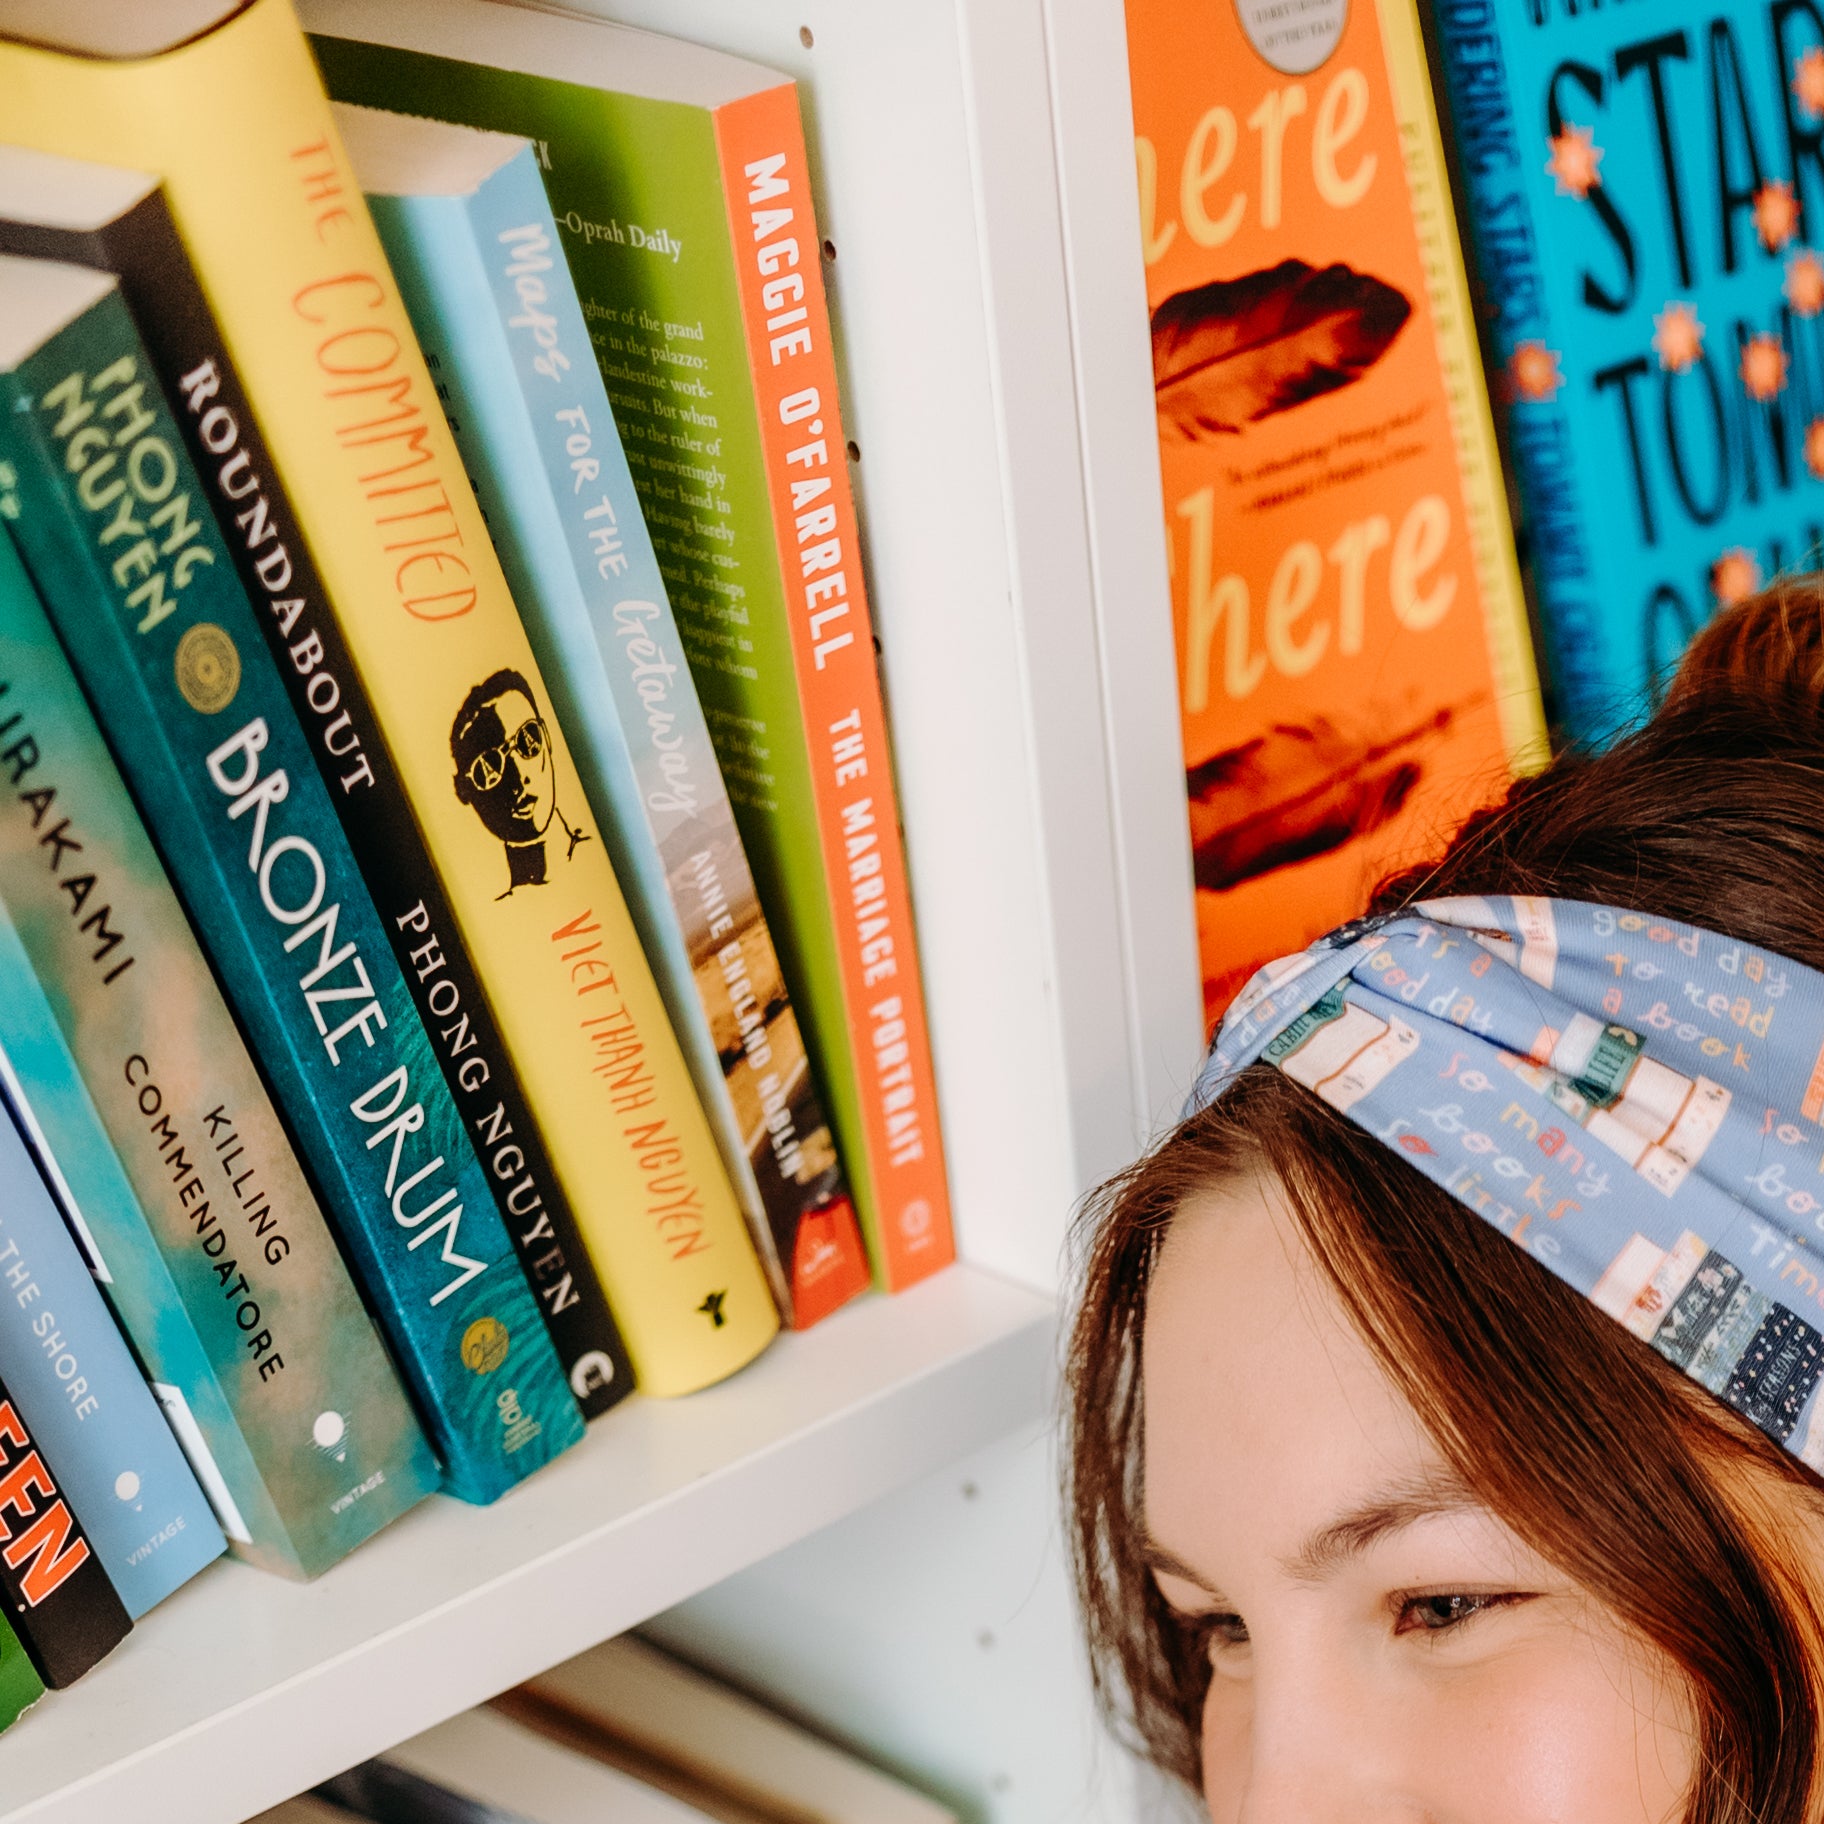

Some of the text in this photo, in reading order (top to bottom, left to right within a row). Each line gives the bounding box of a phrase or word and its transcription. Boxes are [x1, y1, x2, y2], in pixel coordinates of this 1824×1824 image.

[289, 130, 357, 249] THE
[628, 224, 683, 263] Daily
[744, 152, 815, 366] MAGGIE
[639, 309, 661, 333] the
[664, 322, 704, 342] grand
[651, 345, 709, 371] palazzo:
[290, 268, 478, 625] COMMITTED
[670, 378, 714, 400] work-
[671, 431, 704, 454] ruler
[706, 439, 723, 458] of
[680, 406, 719, 430] when
[41, 371, 178, 635] NGUYEN
[89, 354, 216, 589] PHONG
[500, 222, 698, 820] Maps FOR THE Getaway
[692, 515, 735, 548] barely
[1166, 488, 1459, 716] here
[179, 358, 377, 795] ROUNDABOUT
[395, 899, 490, 1095] PHONG
[476, 1101, 581, 1317] NGUYEN
[690, 849, 735, 940] ANNIE
[718, 942, 771, 1072] ENGLAND
[828, 708, 925, 1168] THE MARRIAGE PORTRAIT
[1370, 951, 1495, 1032] ood day
[1592, 910, 1793, 1000] good day
[1604, 952, 1776, 1039] to read
[205, 715, 489, 1308] BRONZE DRUM
[1602, 988, 1751, 1073] a book
[551, 908, 715, 1262] VIET THANH NGUYEN
[1378, 1118, 1439, 1158] so
[1438, 1051, 1611, 1198] so many
[1758, 1108, 1809, 1145] so
[124, 1053, 286, 1384] COMMENDATORE
[201, 1104, 292, 1268] KILLING
[1417, 1103, 1583, 1221] books
[0, 1238, 100, 1421] THE SHORE
[125, 1515, 187, 1568] VINTAGE
[329, 1470, 387, 1516] VINTAGE
